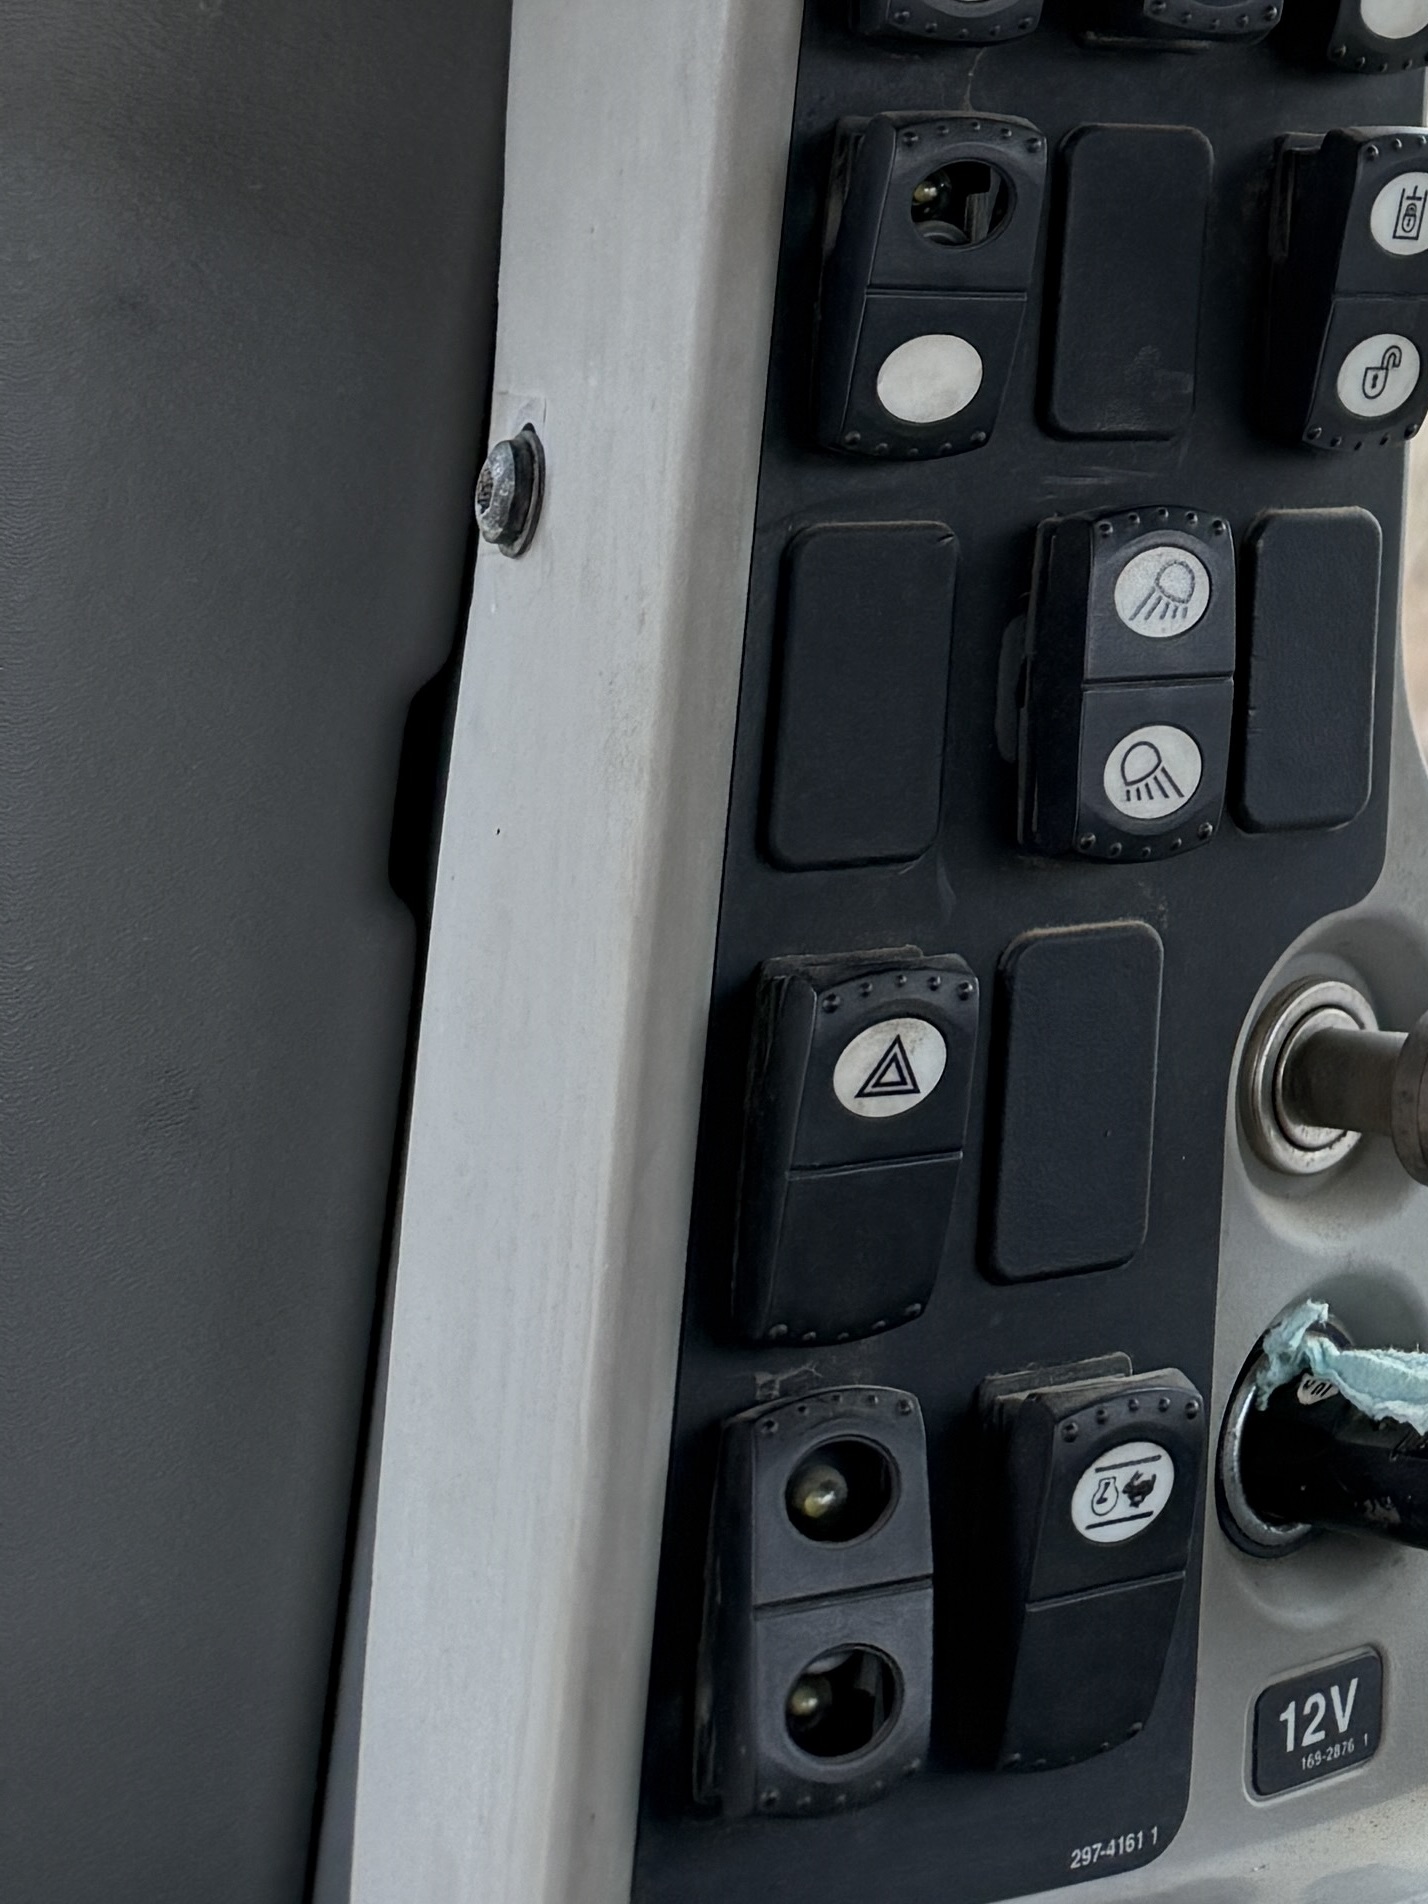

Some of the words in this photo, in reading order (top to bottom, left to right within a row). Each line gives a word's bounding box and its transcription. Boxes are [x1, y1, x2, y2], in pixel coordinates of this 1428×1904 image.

[1279, 1677, 1359, 1753] 12V
[1300, 1737, 1355, 1771] 169-2876
[1070, 1830, 1144, 1870] 297-4161
[1150, 1826, 1158, 1845] 1
